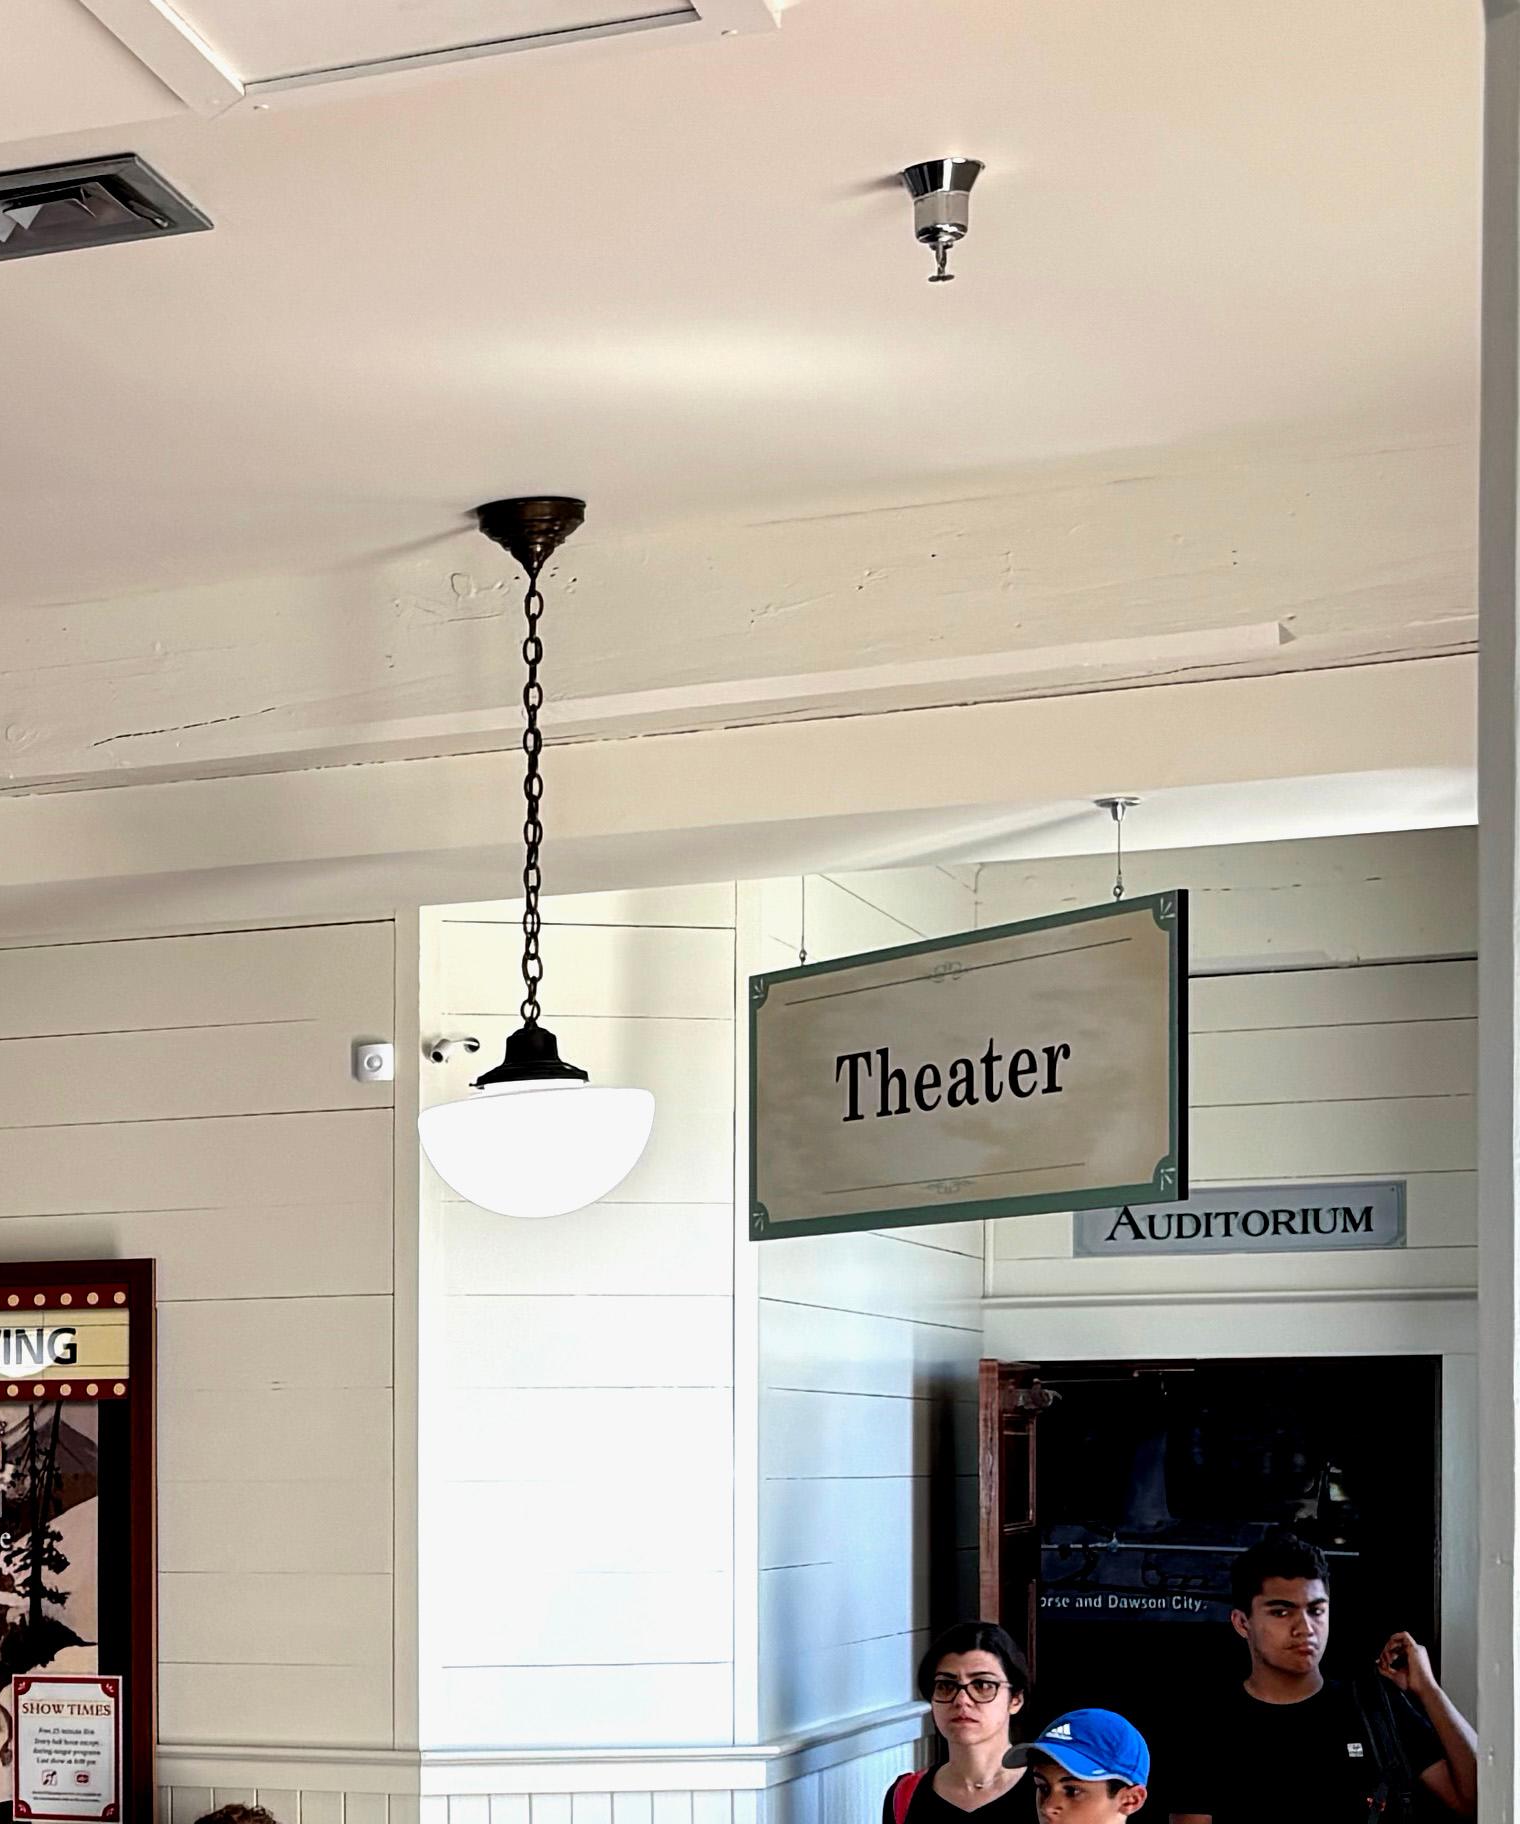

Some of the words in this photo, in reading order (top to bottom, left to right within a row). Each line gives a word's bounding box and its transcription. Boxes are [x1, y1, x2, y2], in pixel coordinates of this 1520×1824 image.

[835, 1036, 1071, 1122] Theater
[1075, 1595, 1102, 1608] and
[1108, 1595, 1166, 1609] Dawson
[22, 1702, 66, 1715] SHOW
[67, 1703, 111, 1716] TIMES
